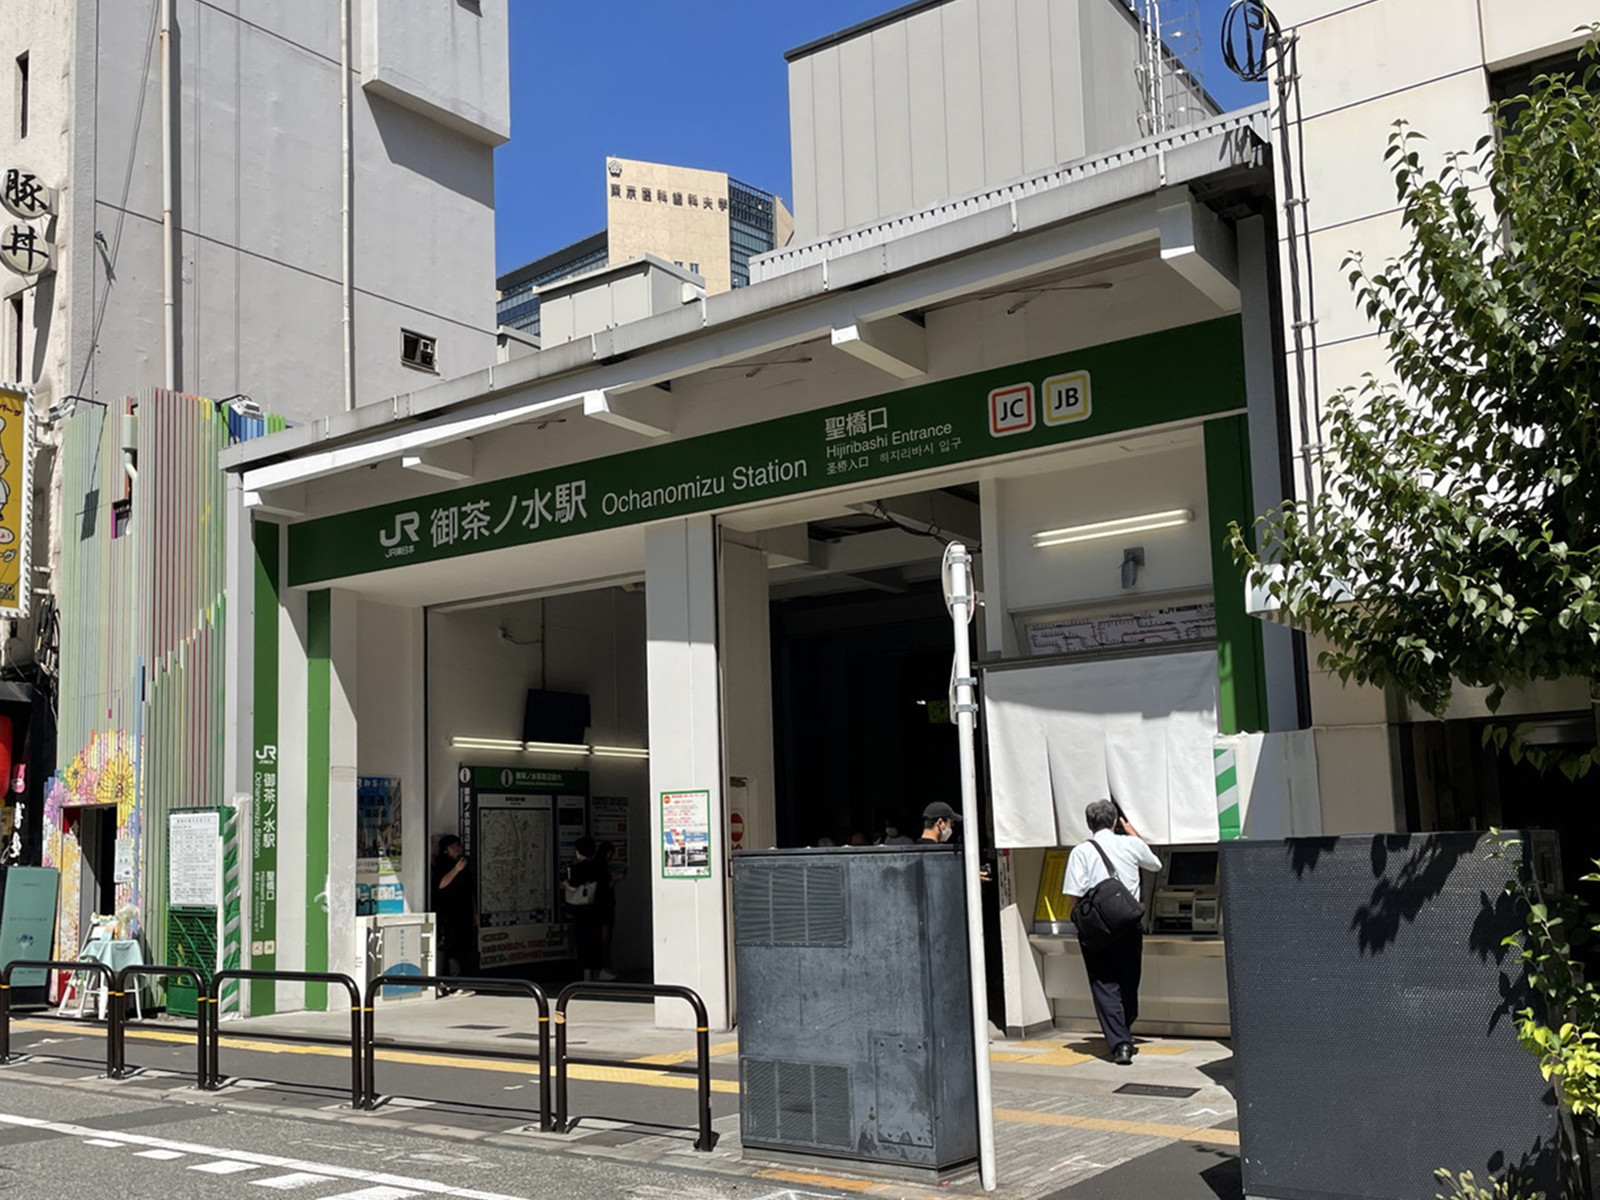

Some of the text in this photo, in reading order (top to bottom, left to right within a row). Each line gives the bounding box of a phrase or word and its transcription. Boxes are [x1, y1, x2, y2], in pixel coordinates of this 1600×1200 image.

[1000, 398, 1024, 421] JC
[1054, 386, 1079, 410] JB
[824, 407, 888, 441] 聖橋口
[826, 423, 952, 459] Hijiribashi Entrance
[939, 437, 962, 453] 입구
[602, 459, 807, 516] Ochanomizu Station
[379, 511, 420, 547] JR
[430, 479, 588, 549] 御茶ノ水駅
[255, 745, 277, 760] JR
[254, 772, 262, 858] Ochanomizu Station
[263, 773, 276, 848] 御茶ノ水駅
